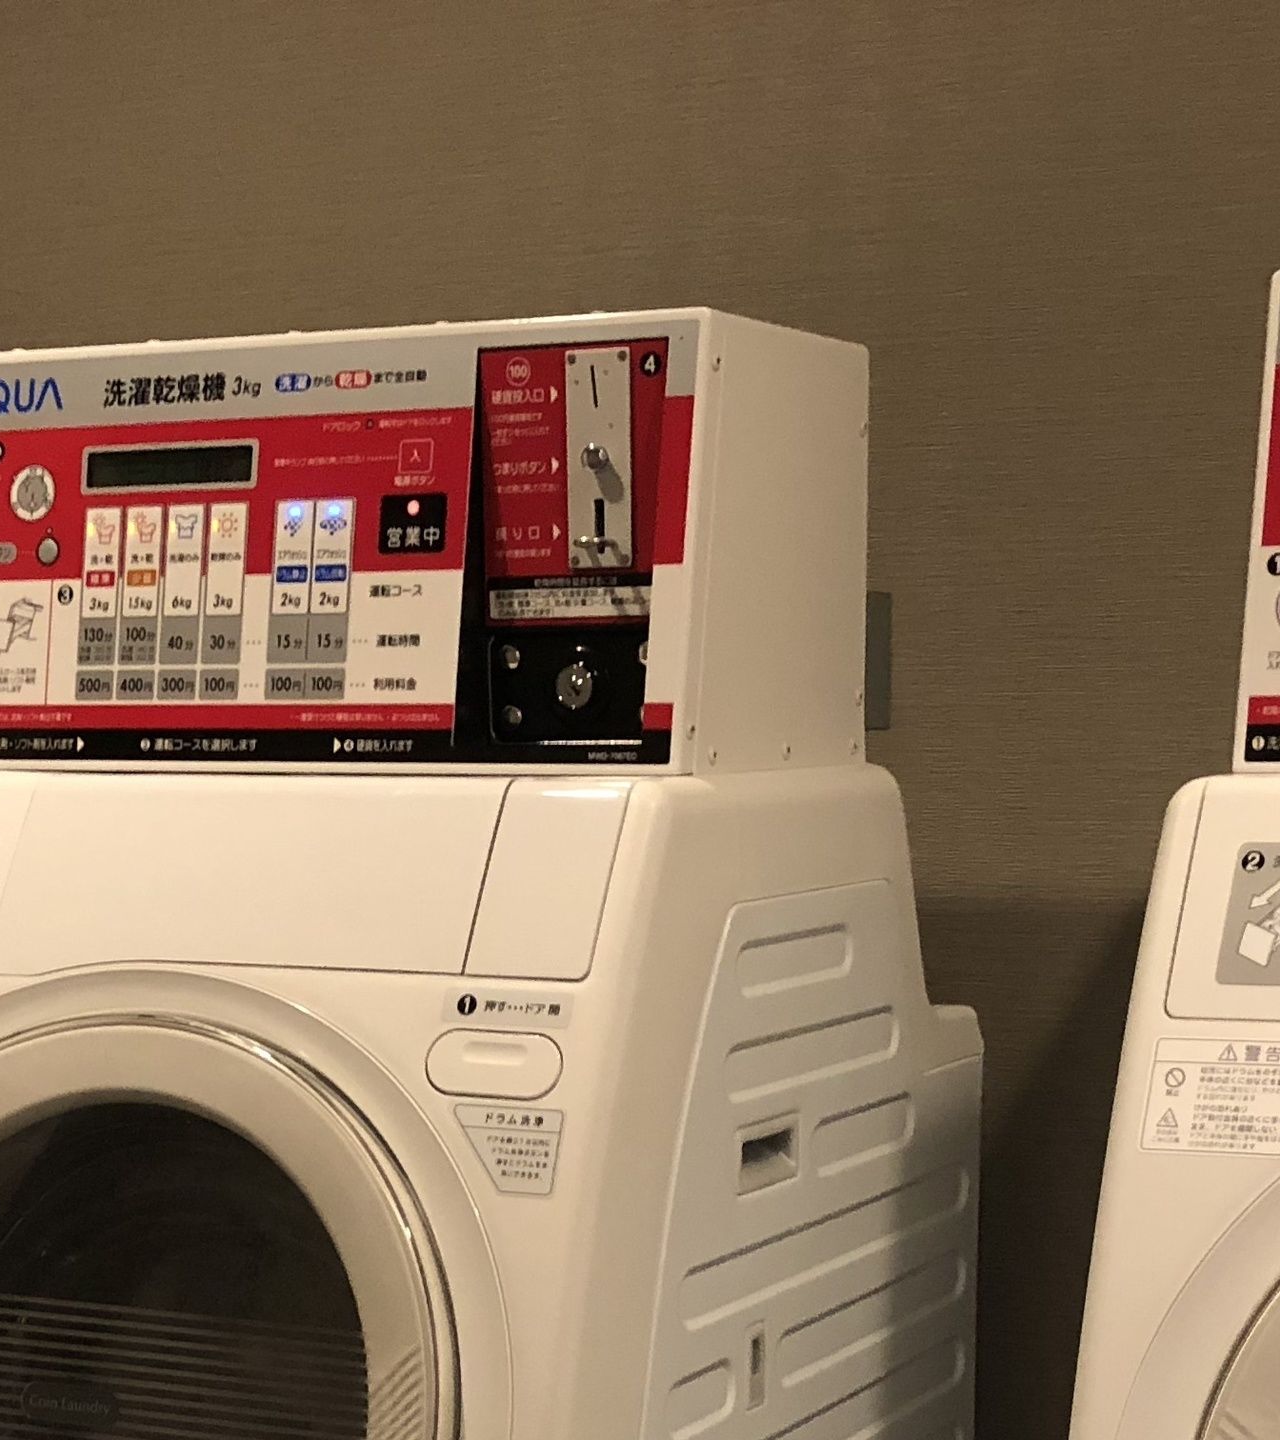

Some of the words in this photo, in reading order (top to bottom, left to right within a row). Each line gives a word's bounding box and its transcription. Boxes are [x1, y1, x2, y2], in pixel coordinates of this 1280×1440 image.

[104, 371, 227, 409] 洗濯乾燥機
[231, 376, 262, 397] 3kg
[386, 526, 440, 548] 営業中
[89, 597, 109, 612] 3kg
[172, 593, 192, 609] 6kg
[213, 594, 233, 609] 3kg
[280, 592, 301, 608] 2kg
[319, 592, 340, 607] 2kg
